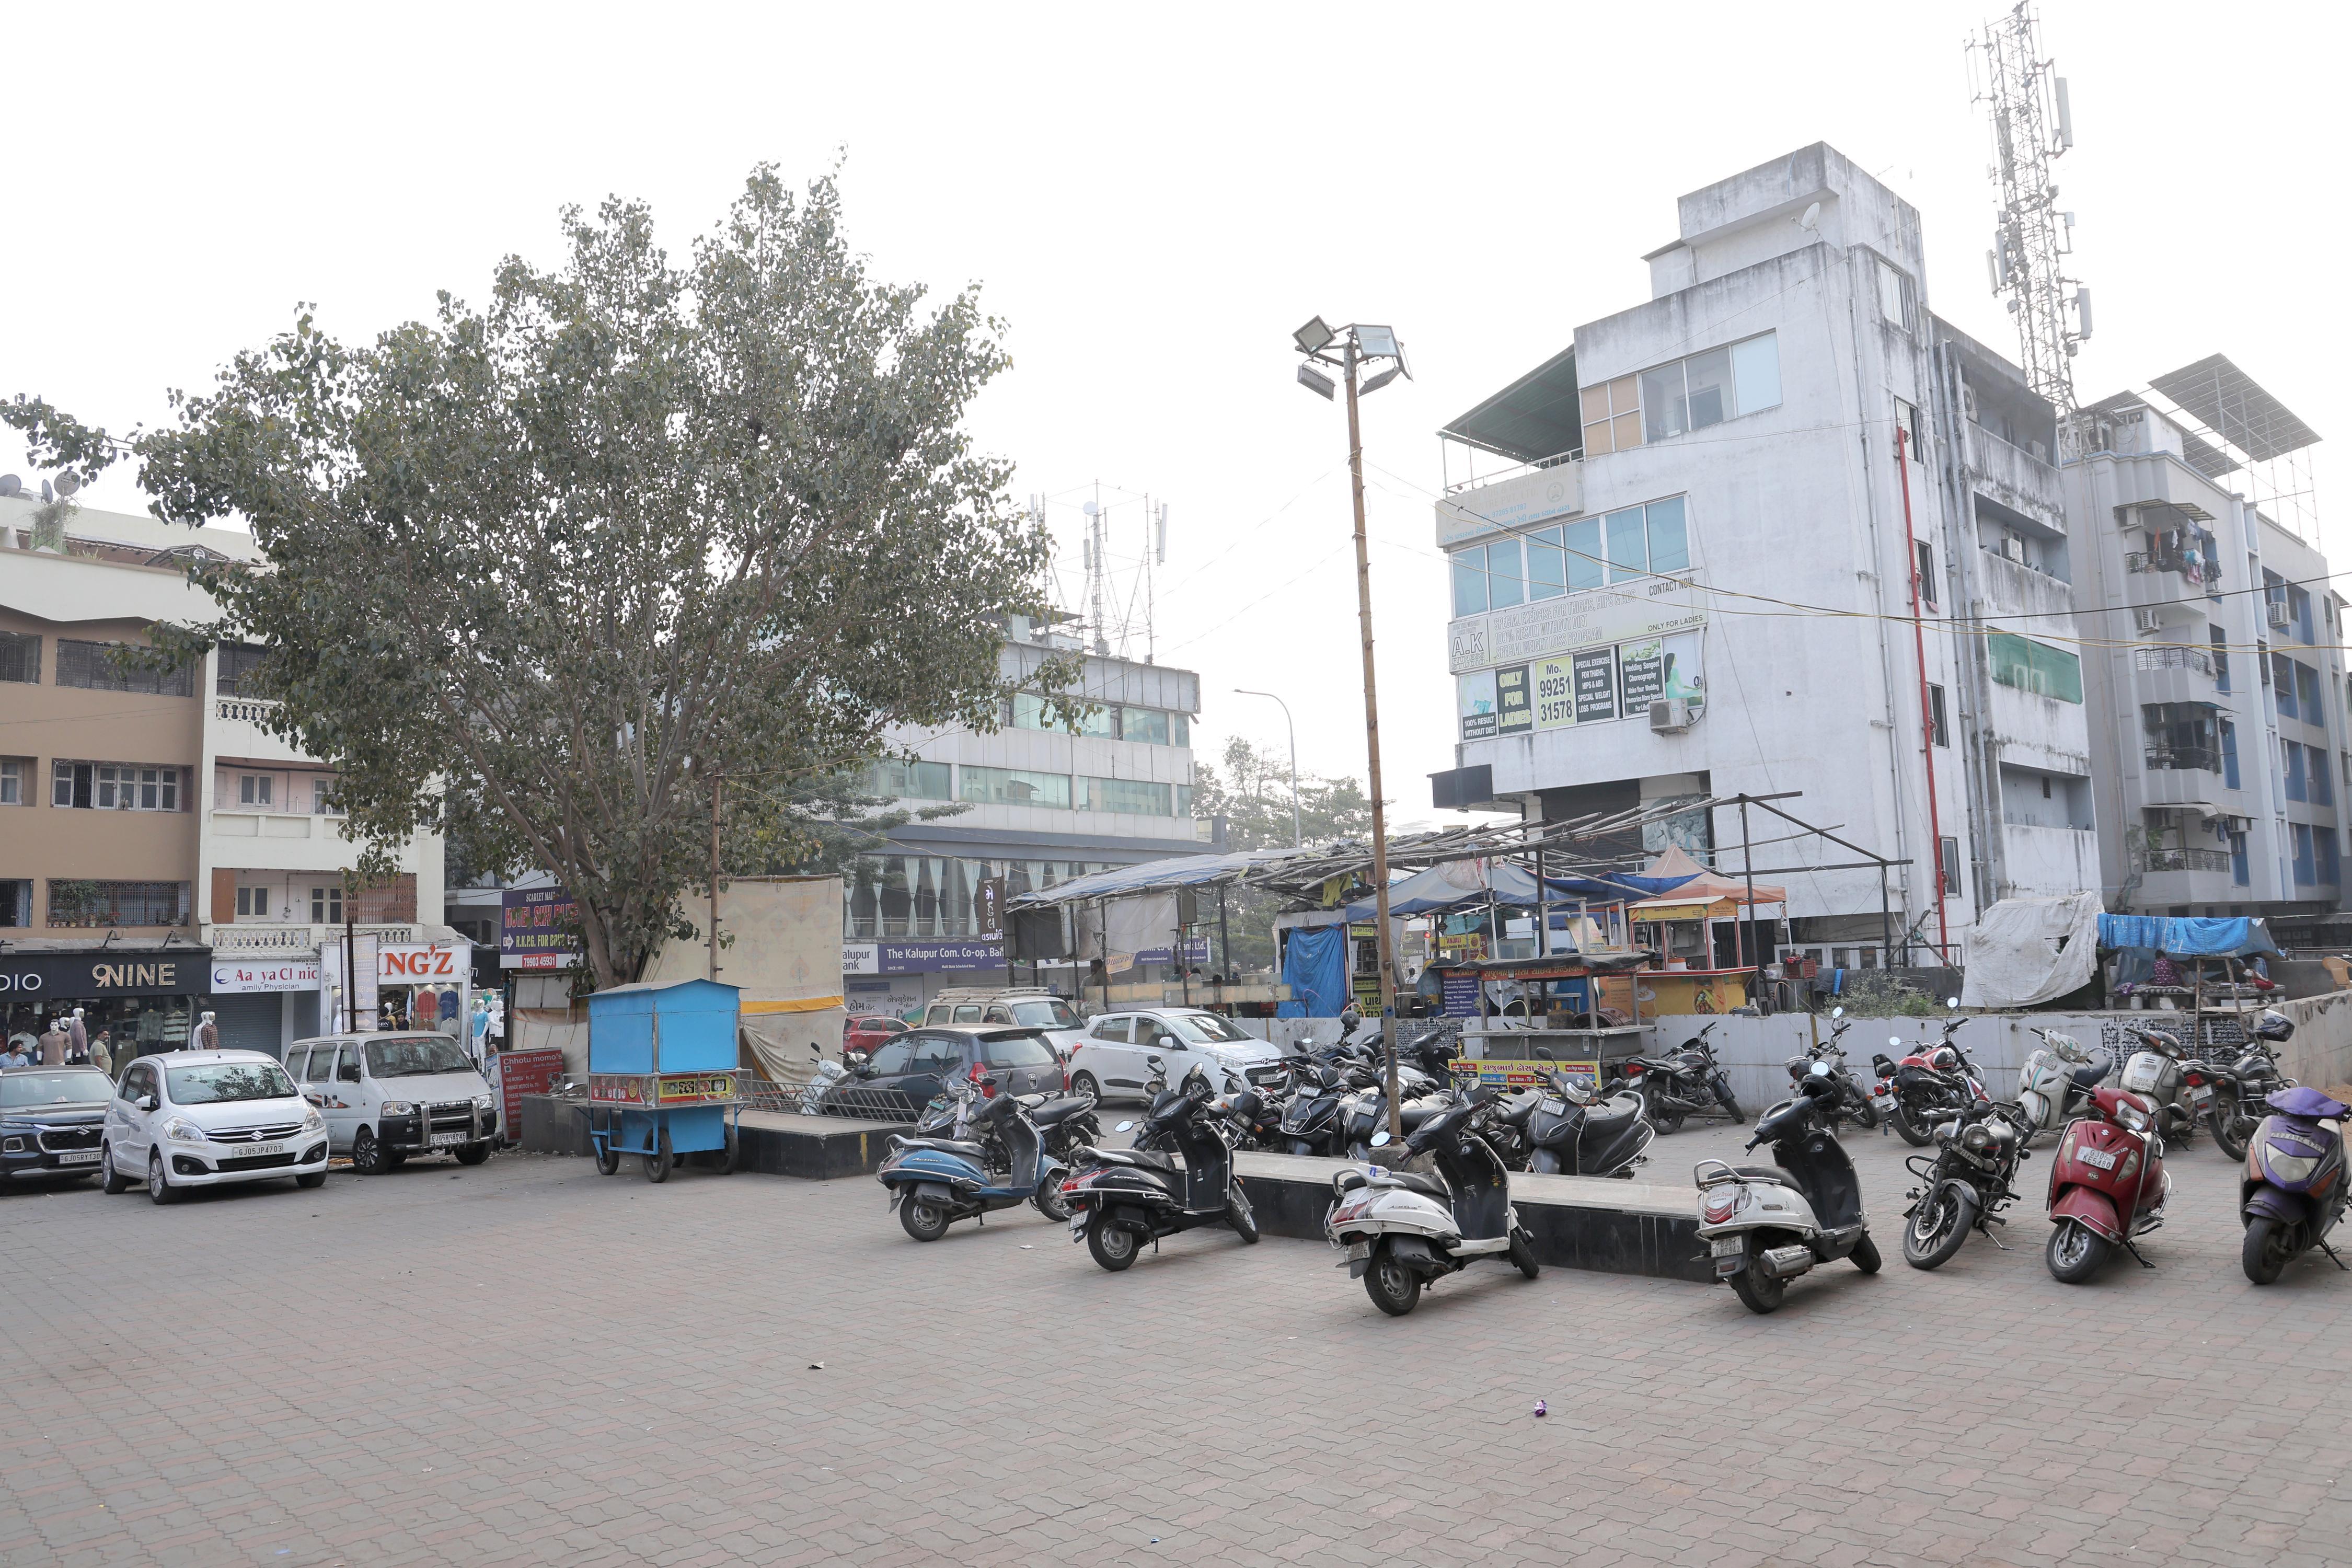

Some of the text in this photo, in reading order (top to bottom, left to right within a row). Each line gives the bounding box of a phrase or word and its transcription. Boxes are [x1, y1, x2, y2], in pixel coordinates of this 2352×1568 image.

[1649, 580, 1677, 596] CONTACT
[1494, 614, 1520, 630] SPECIAL
[1521, 607, 1552, 625] EXERCISE
[1553, 605, 1567, 618] FOR
[1596, 594, 1613, 609] HIPS
[1495, 614, 1588, 645] 100% RESULT WITHOUT DIET
[1647, 615, 1703, 632] ONLY FOR LADIES
[1452, 632, 1484, 657] A.K
[1495, 627, 1602, 659] SPECIAL WEIGHT LOSS PROGRAM
[1452, 652, 1485, 664] FITNESS
[1575, 656, 1610, 669] SPECIAL EXERCISE
[1451, 659, 1485, 671] STUDIO
[1546, 664, 1562, 675] Mo.
[1624, 661, 1660, 673] Wedding Sangeet
[1499, 671, 1523, 688] ONLY
[1581, 670, 1590, 679] FOR
[1629, 671, 1656, 683] Choreography
[1540, 675, 1571, 698] 99251
[1582, 681, 1592, 690] HIPS
[1595, 679, 1604, 688] ABS
[1645, 683, 1659, 692] Wedding
[1504, 690, 1524, 707] FOR
[1577, 693, 1594, 702] SPECIAL
[1625, 695, 1642, 704] Memories
[1650, 691, 1663, 701] Special
[1541, 699, 1573, 722] 31578
[1578, 701, 1612, 713] LOSS PROGRAMS
[1465, 716, 1494, 728] 100% RESULT
[1499, 709, 1531, 728] LADIES
[1465, 725, 1496, 737] WITHOUT DIET
[526, 892, 544, 902] SCARLET
[537, 935, 548, 947] FOR
[843, 949, 870, 961] alupur
[887, 947, 1004, 961] The Kalupur Com. Co-op. Ban
[524, 955, 555, 967] 79903 45931
[843, 960, 860, 971] ank
[503, 1057, 531, 1065] Chhotu
[533, 1053, 562, 1062] momo's
[239, 1146, 282, 1156] GJ05JP4703
[64, 1153, 100, 1162] GJ05RY130
